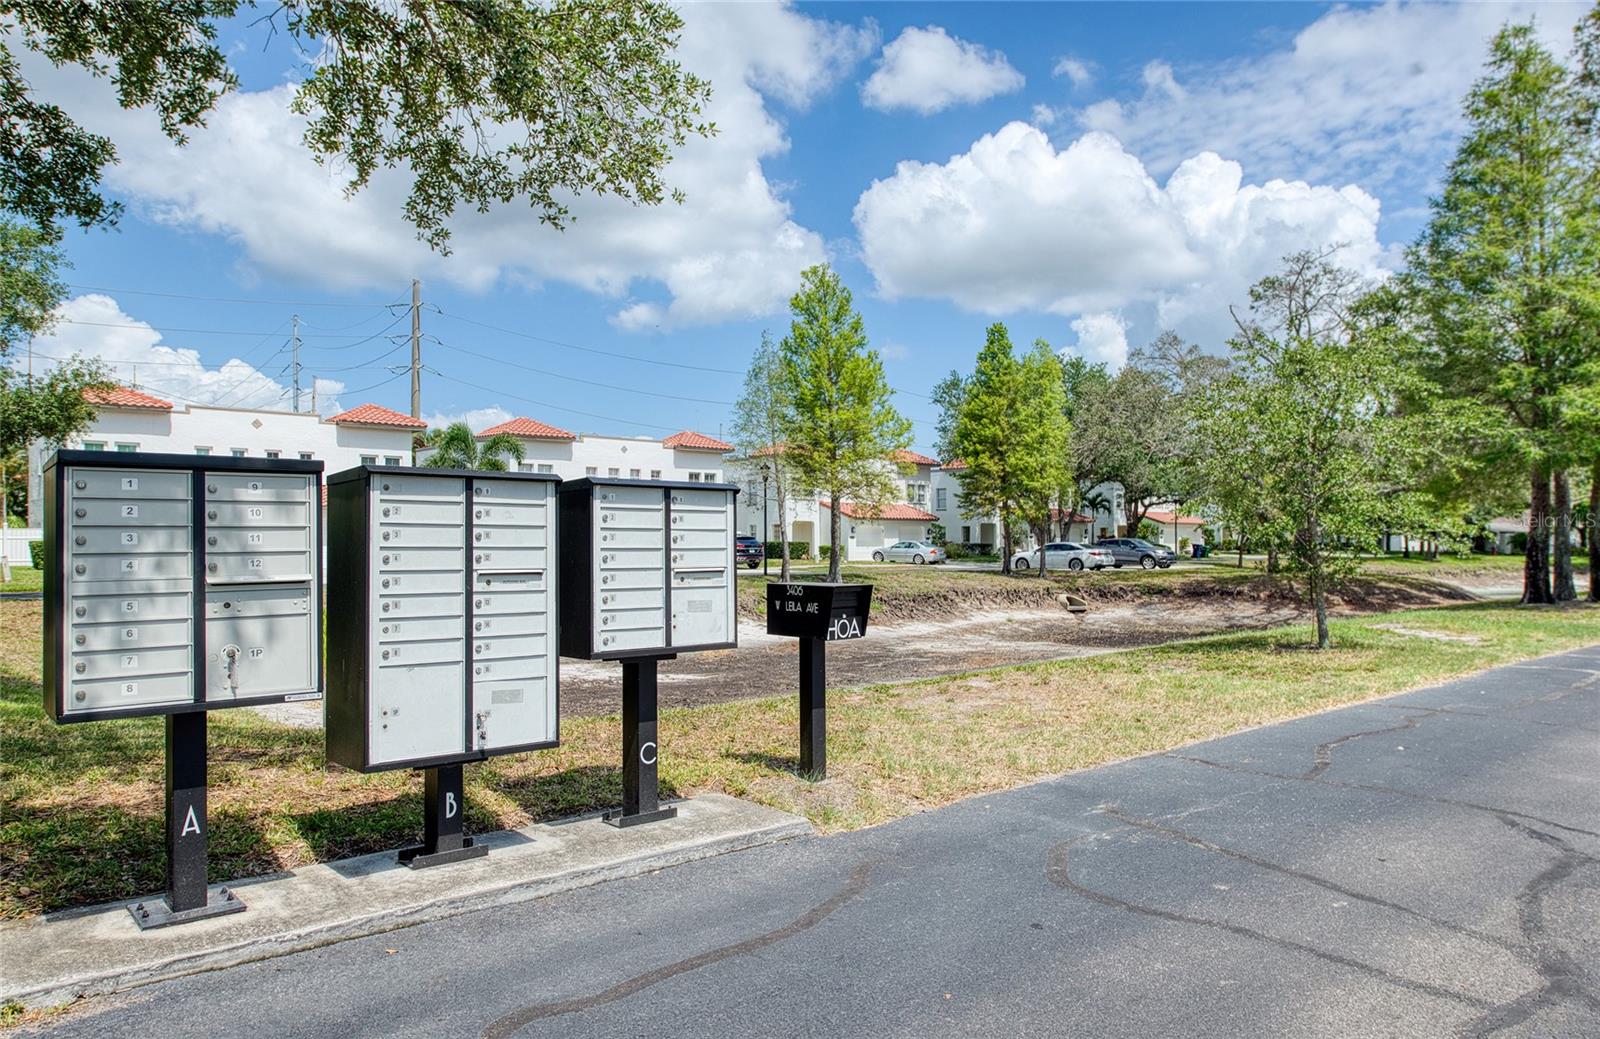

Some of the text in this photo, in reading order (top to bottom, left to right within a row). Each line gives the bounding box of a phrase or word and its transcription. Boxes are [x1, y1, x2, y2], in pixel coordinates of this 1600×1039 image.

[127, 479, 133, 488] 1
[251, 482, 259, 491] 9
[126, 506, 134, 515] 2
[250, 508, 262, 517] 10
[126, 533, 134, 542] 3
[250, 534, 261, 542] 11
[126, 560, 134, 569] 4
[250, 559, 262, 568] 12
[126, 602, 134, 611] 5
[805, 602, 819, 614] AVE
[126, 628, 134, 638] 6
[250, 648, 263, 657] 1P
[126, 656, 134, 665] 7
[126, 683, 134, 693] 8
[640, 741, 657, 765] C
[445, 791, 457, 819] B
[180, 804, 201, 836] A
